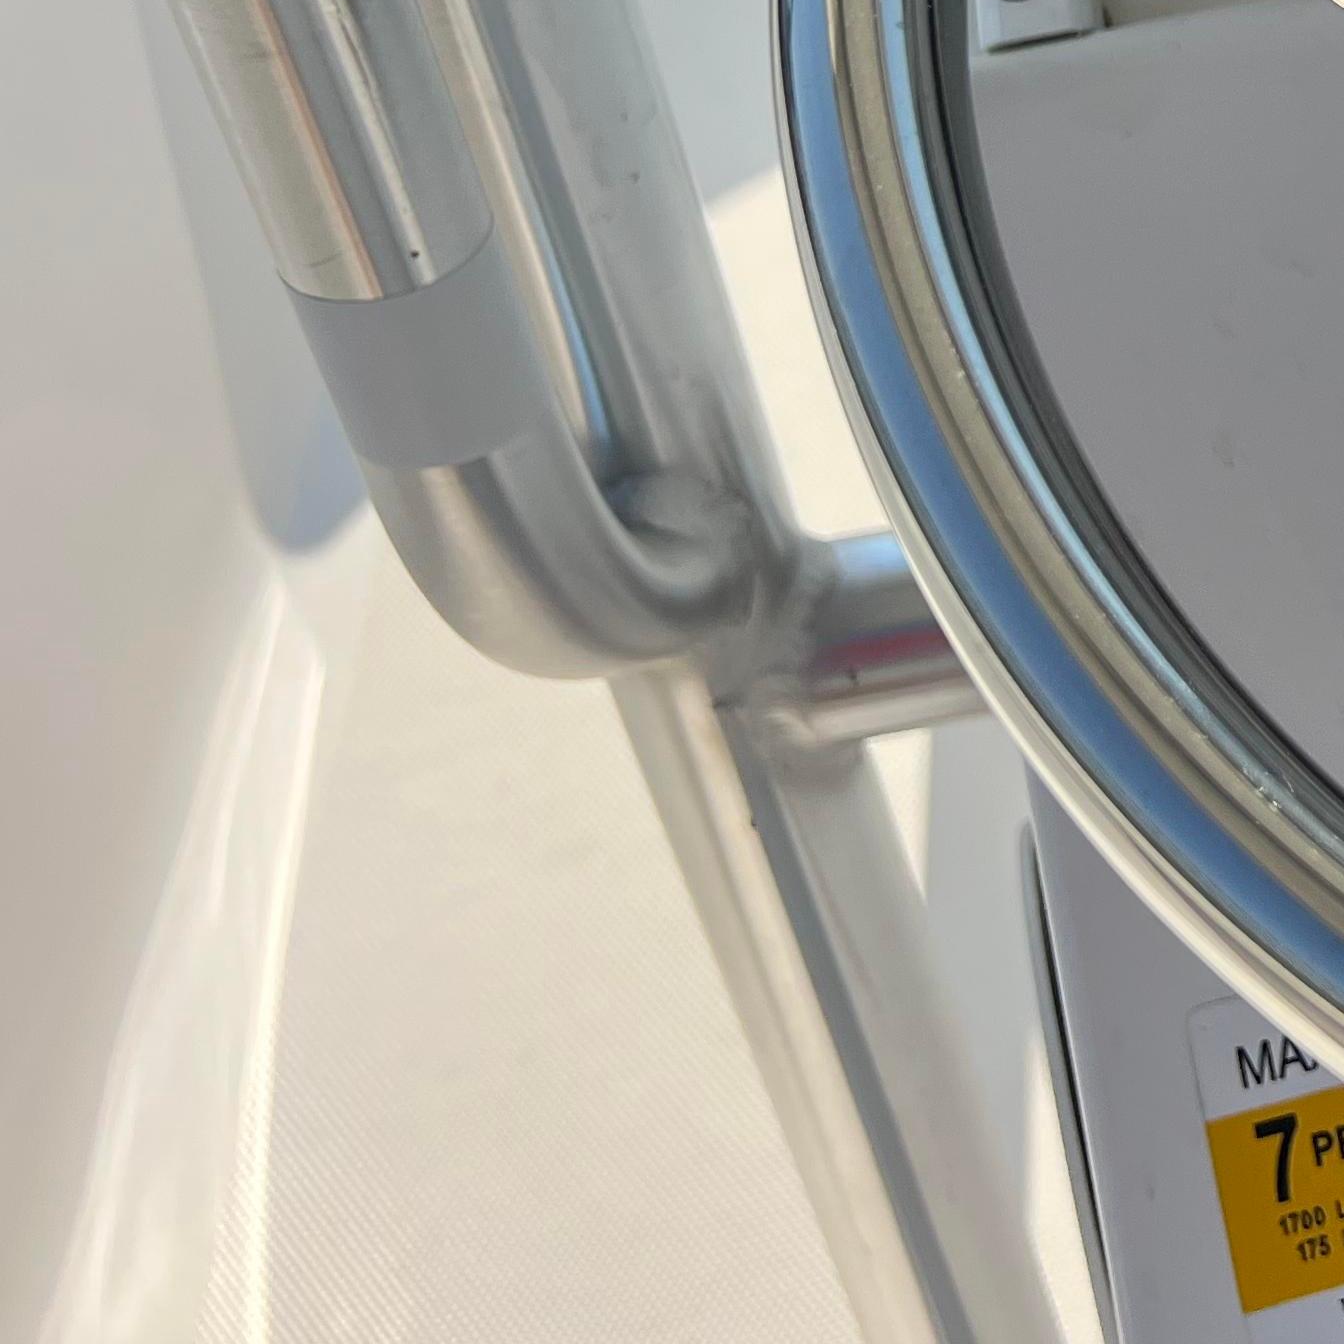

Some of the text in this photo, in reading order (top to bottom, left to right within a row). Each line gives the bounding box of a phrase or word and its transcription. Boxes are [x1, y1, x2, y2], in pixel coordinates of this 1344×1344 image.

[1254, 1111, 1298, 1204] 7
[1279, 1205, 1327, 1237] 1700
[1297, 1233, 1332, 1262] 175
